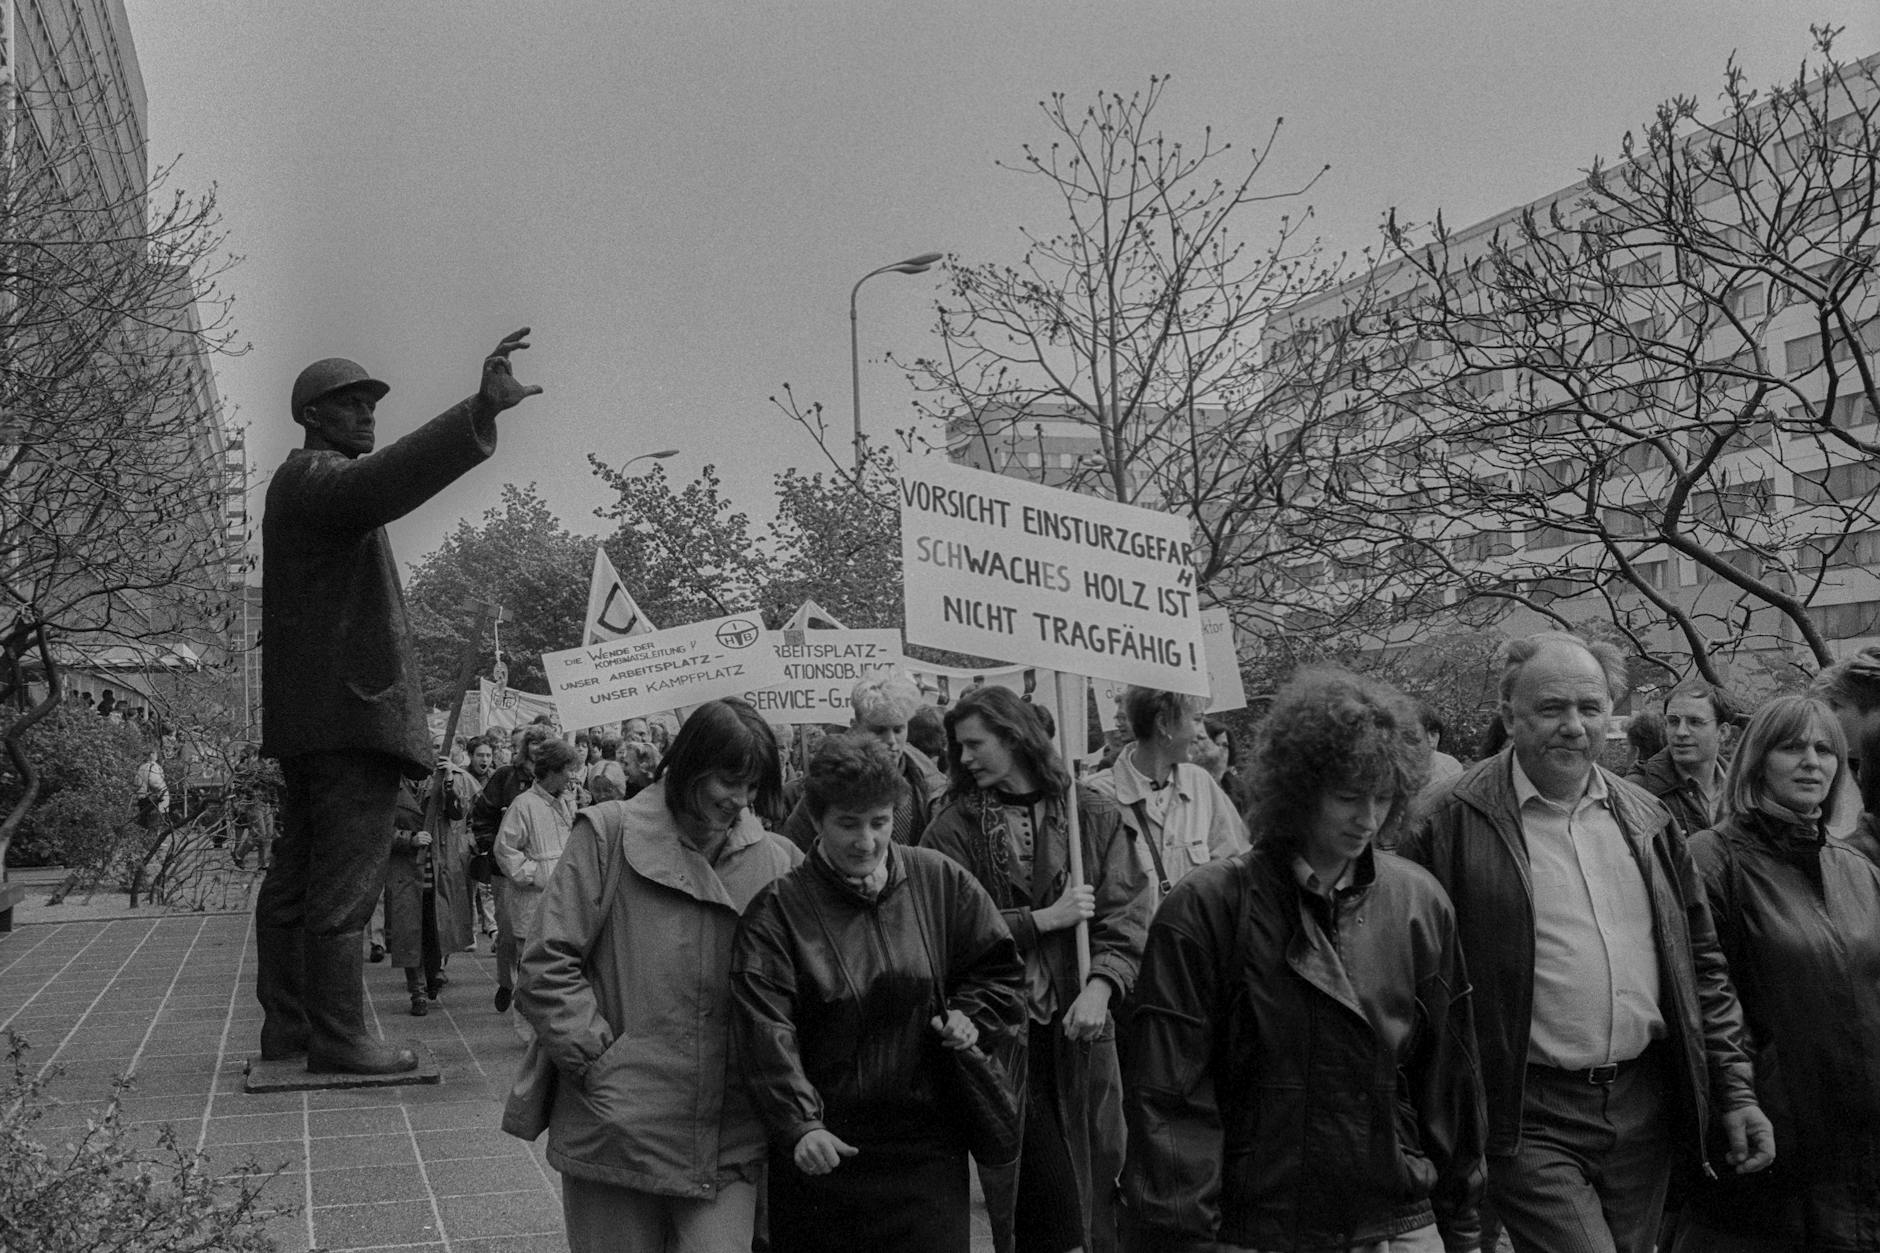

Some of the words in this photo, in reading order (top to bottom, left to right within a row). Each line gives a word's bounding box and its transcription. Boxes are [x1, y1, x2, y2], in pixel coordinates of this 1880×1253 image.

[901, 477, 1011, 528] VORSICHT
[916, 536, 1071, 592] SCHWACHES
[1083, 570, 1150, 611] HOLZ
[1158, 586, 1191, 618] IST
[943, 595, 1018, 635] NICHT
[563, 657, 583, 666] DIE
[587, 647, 630, 661] WENDE
[633, 642, 655, 652] DER
[595, 645, 687, 670] KOMBINATSLEITUNG
[560, 677, 600, 691] UNSER
[590, 687, 639, 704] UNSER
[646, 664, 746, 693] KAMPFPLATZ
